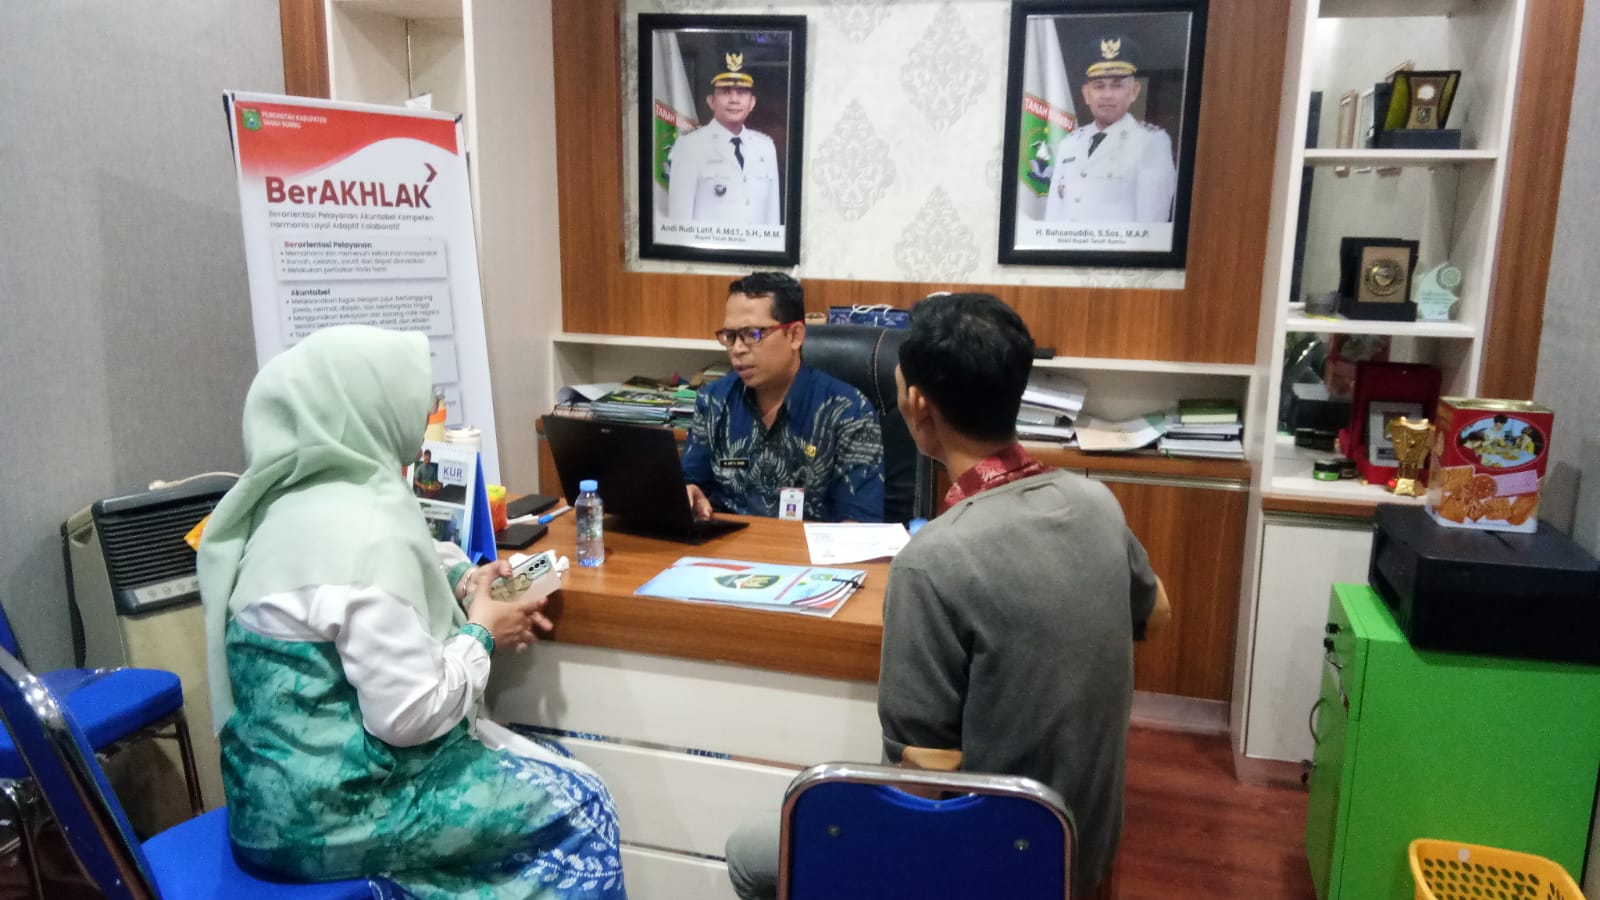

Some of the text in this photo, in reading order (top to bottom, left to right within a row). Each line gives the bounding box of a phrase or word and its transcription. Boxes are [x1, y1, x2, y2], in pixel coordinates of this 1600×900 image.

[1024, 97, 1049, 121] TANAH
[296, 113, 328, 124] KABUPATEN
[265, 175, 432, 209] BerAKHLAK
[269, 209, 317, 219] Berorientasi
[318, 211, 359, 222] Pelayanan
[360, 212, 396, 221] Akuntabel
[333, 222, 360, 232] Adaptif
[660, 223, 678, 232] Andi
[679, 225, 695, 233] Rudi
[284, 240, 373, 251] Berorientasi Pelayanan
[290, 287, 331, 297] Akuntabel
[443, 465, 463, 479] KUR
